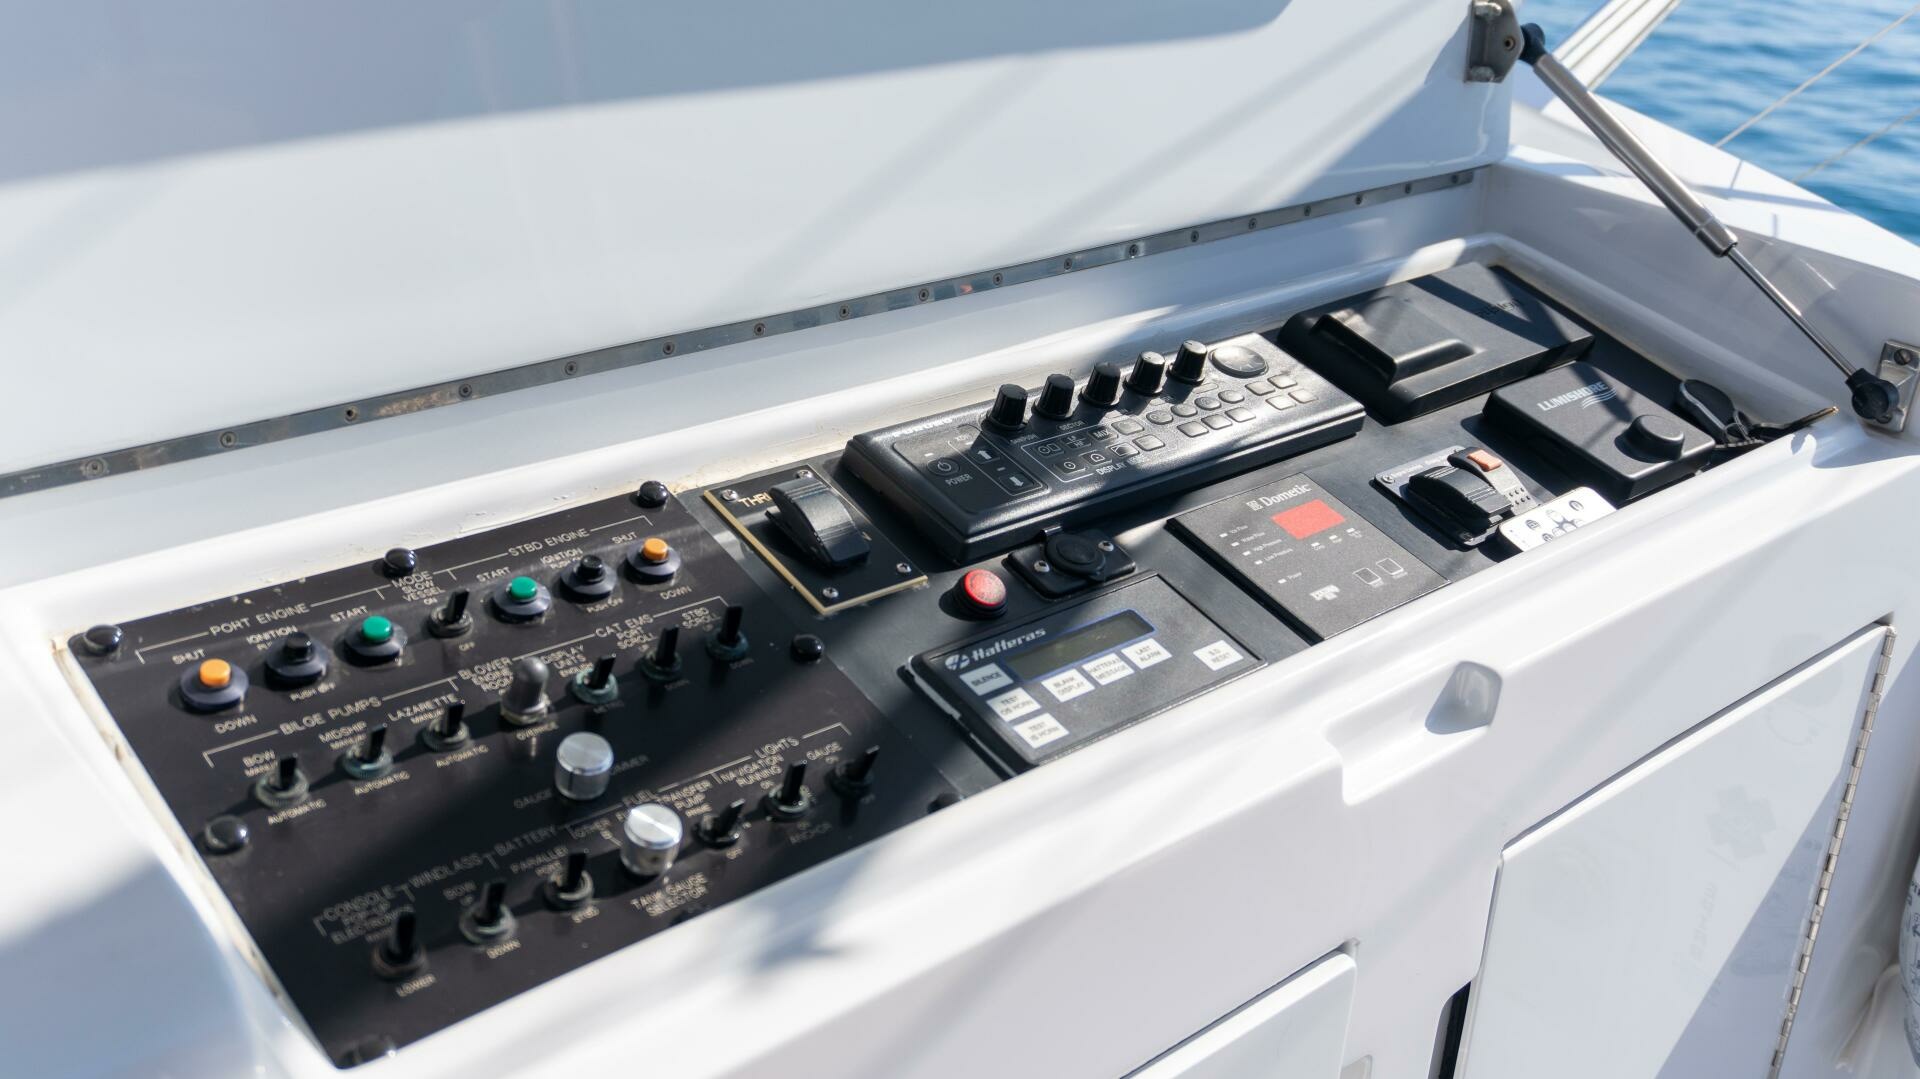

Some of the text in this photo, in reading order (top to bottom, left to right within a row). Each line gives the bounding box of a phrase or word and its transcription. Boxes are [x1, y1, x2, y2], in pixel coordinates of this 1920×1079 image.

[1536, 380, 1609, 411] LUMISHORE
[1093, 428, 1109, 440] MIX
[1095, 461, 1127, 476] DISPLAY
[945, 474, 974, 487] POWER
[1261, 483, 1313, 508] Dometic
[508, 528, 591, 557] STBD ENGINE
[611, 531, 638, 545] SHUT
[540, 547, 584, 565] IGNITION
[391, 571, 434, 588] MODE
[476, 566, 511, 583] START
[401, 579, 436, 595] SLOW
[402, 586, 446, 602] VESSEL
[659, 586, 692, 601] DOWN
[209, 603, 311, 637] PORT ENGINE
[330, 605, 369, 623] START
[246, 625, 299, 645] IGNITION
[595, 613, 655, 639] CAT EMS
[970, 628, 1047, 662] Hatteras
[171, 649, 207, 665] SHUT
[457, 656, 514, 680] BLOWER
[971, 671, 1002, 687] SILENCE
[279, 696, 382, 735] BILGE PUMPS
[387, 693, 459, 722] LAZARETTE
[213, 713, 258, 735] DOWN
[318, 720, 368, 744] MIDSHIP
[242, 750, 277, 767] BOW
[754, 736, 800, 759] LIGHTS
[806, 741, 843, 761] GAUGE
[719, 752, 785, 784] NAVIGATION
[736, 764, 783, 788] RUNNING
[494, 825, 557, 856] BATTERY
[408, 853, 484, 889] WINDLASS
[322, 883, 397, 922] CONSOLE
[631, 872, 709, 910] TANK GAUGE
[646, 885, 708, 917] SELECTOR
[395, 973, 437, 998] LOWER
